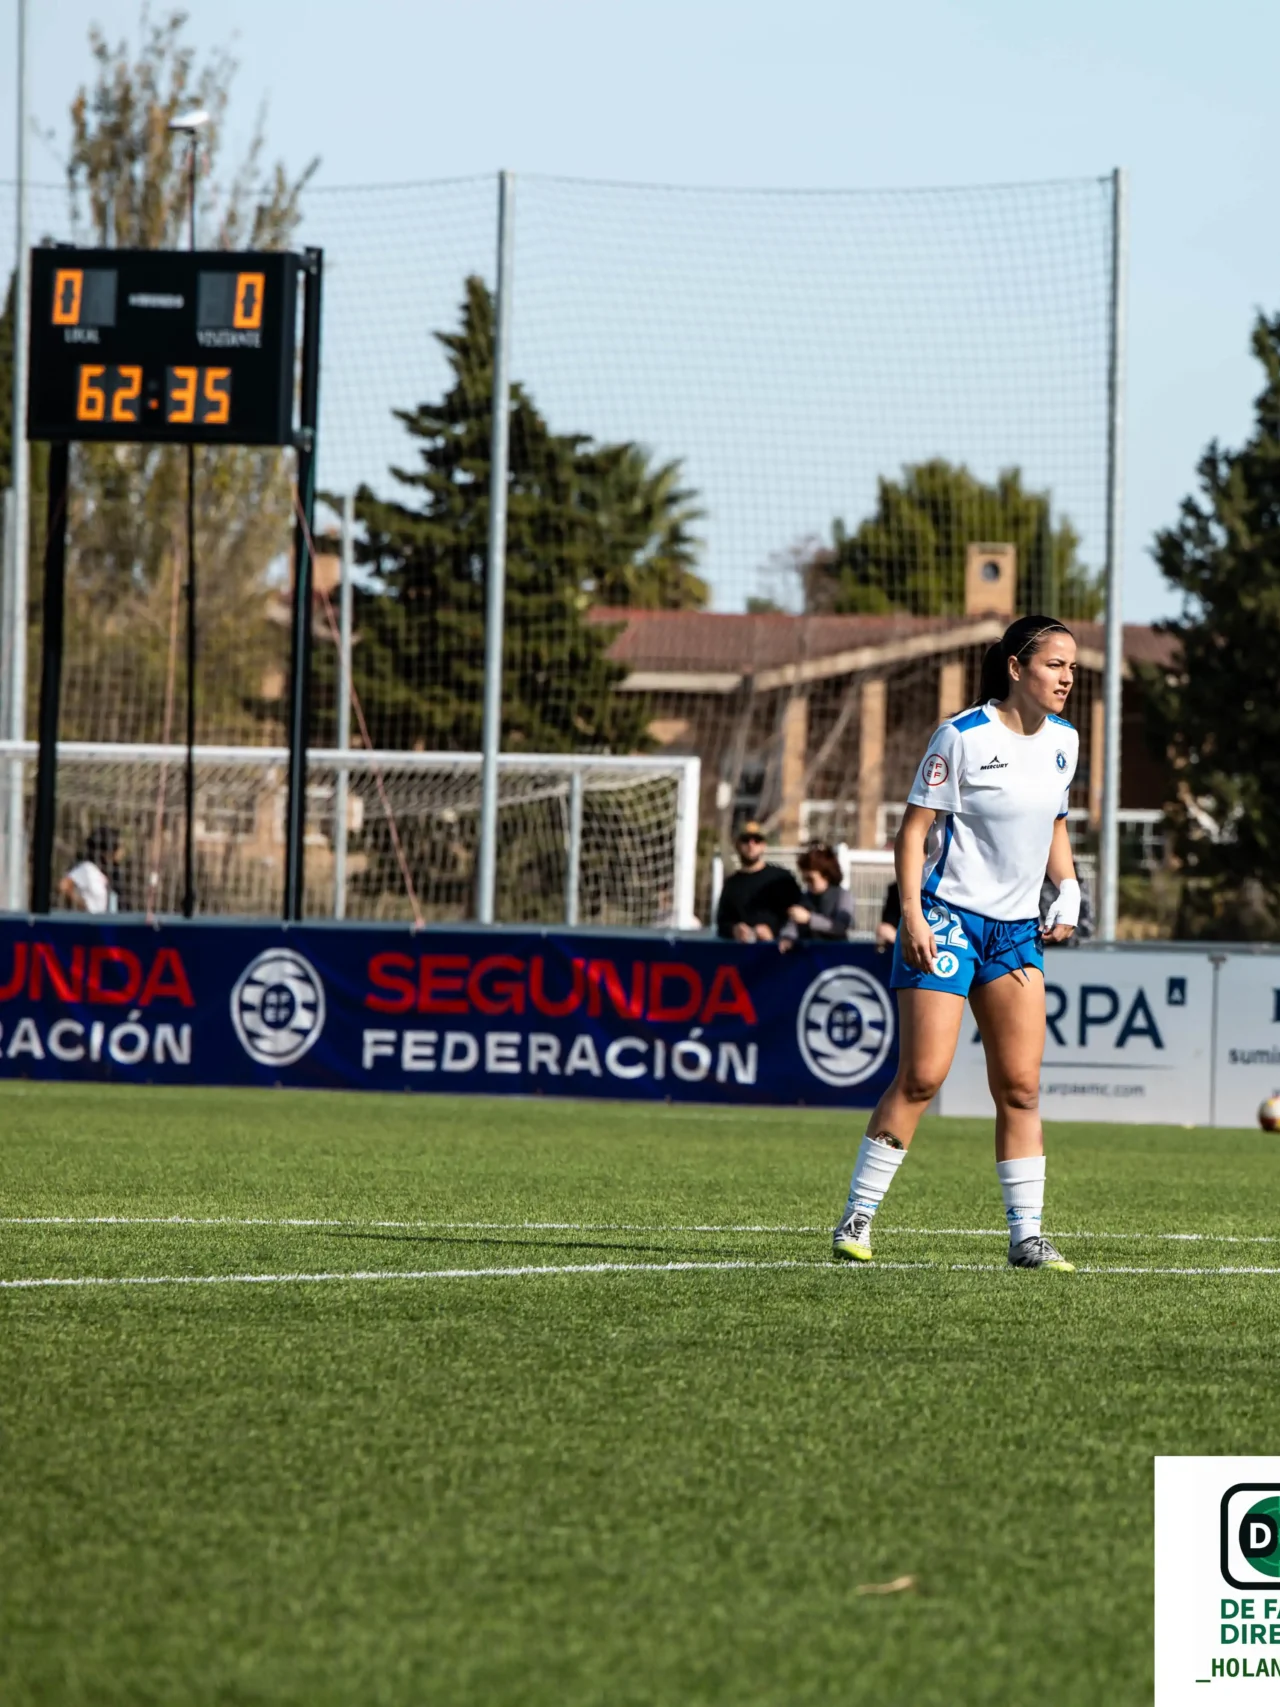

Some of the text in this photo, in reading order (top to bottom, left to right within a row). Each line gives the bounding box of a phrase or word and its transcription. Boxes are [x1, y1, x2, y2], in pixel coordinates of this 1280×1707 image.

[52, 269, 83, 325] 0
[233, 273, 265, 329] 0
[928, 906, 969, 950] 22
[364, 952, 758, 1025] SEGUNDA
[0, 1009, 192, 1066] ACIÓN
[972, 984, 1164, 1050] RPA
[362, 1029, 758, 1085] FEDERACIÓN
